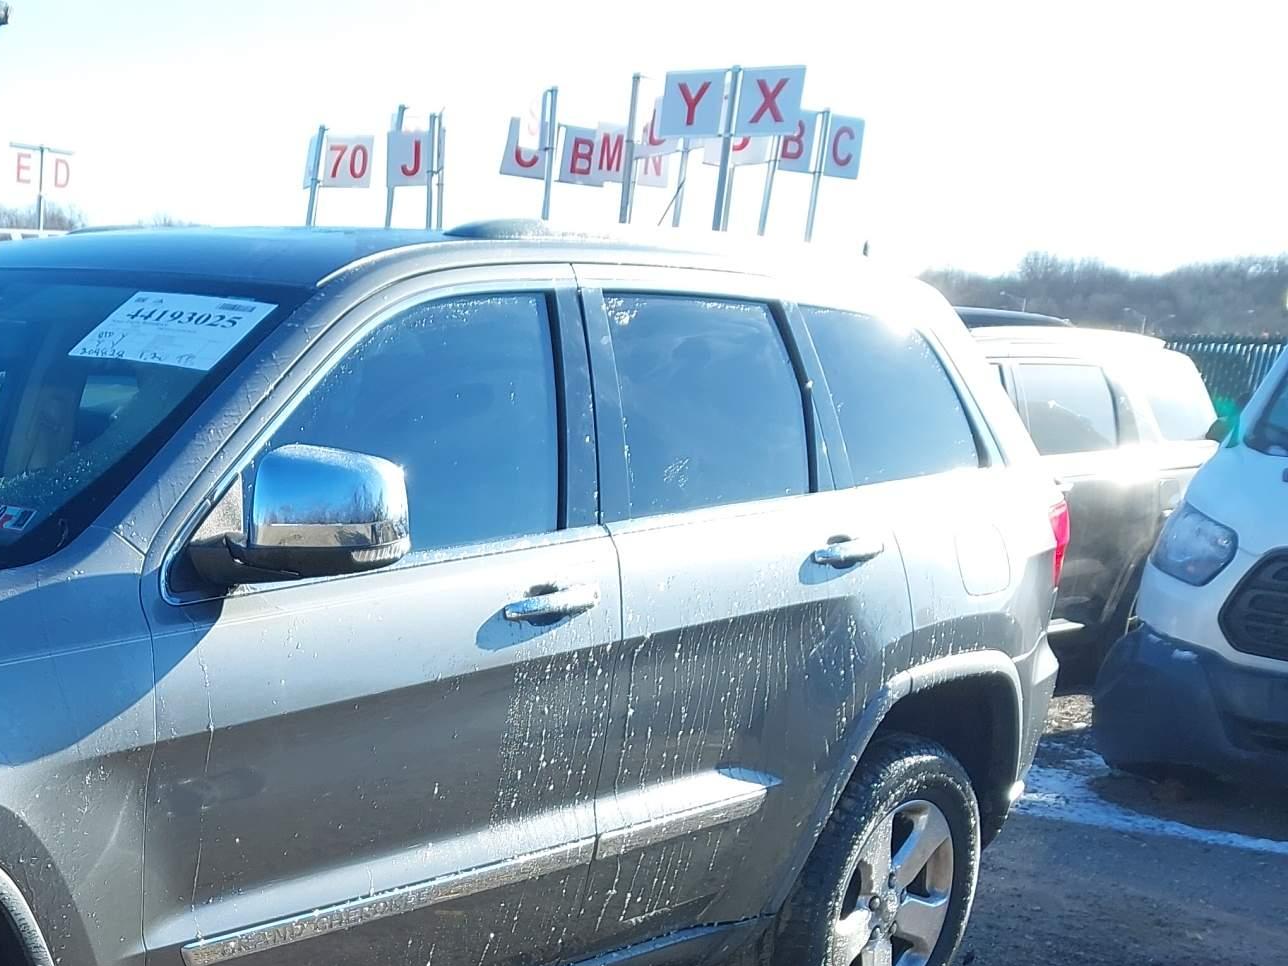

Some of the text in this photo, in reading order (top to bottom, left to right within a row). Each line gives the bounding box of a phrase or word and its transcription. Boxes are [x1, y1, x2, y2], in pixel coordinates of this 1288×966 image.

[678, 80, 712, 126] Y
[748, 77, 791, 123] X
[330, 144, 368, 179] 70
[401, 139, 421, 177] J
[570, 137, 594, 176] B
[598, 133, 624, 172] M
[832, 126, 856, 167] C
[16, 152, 70, 188] E D
[126, 307, 244, 329] 44193025
